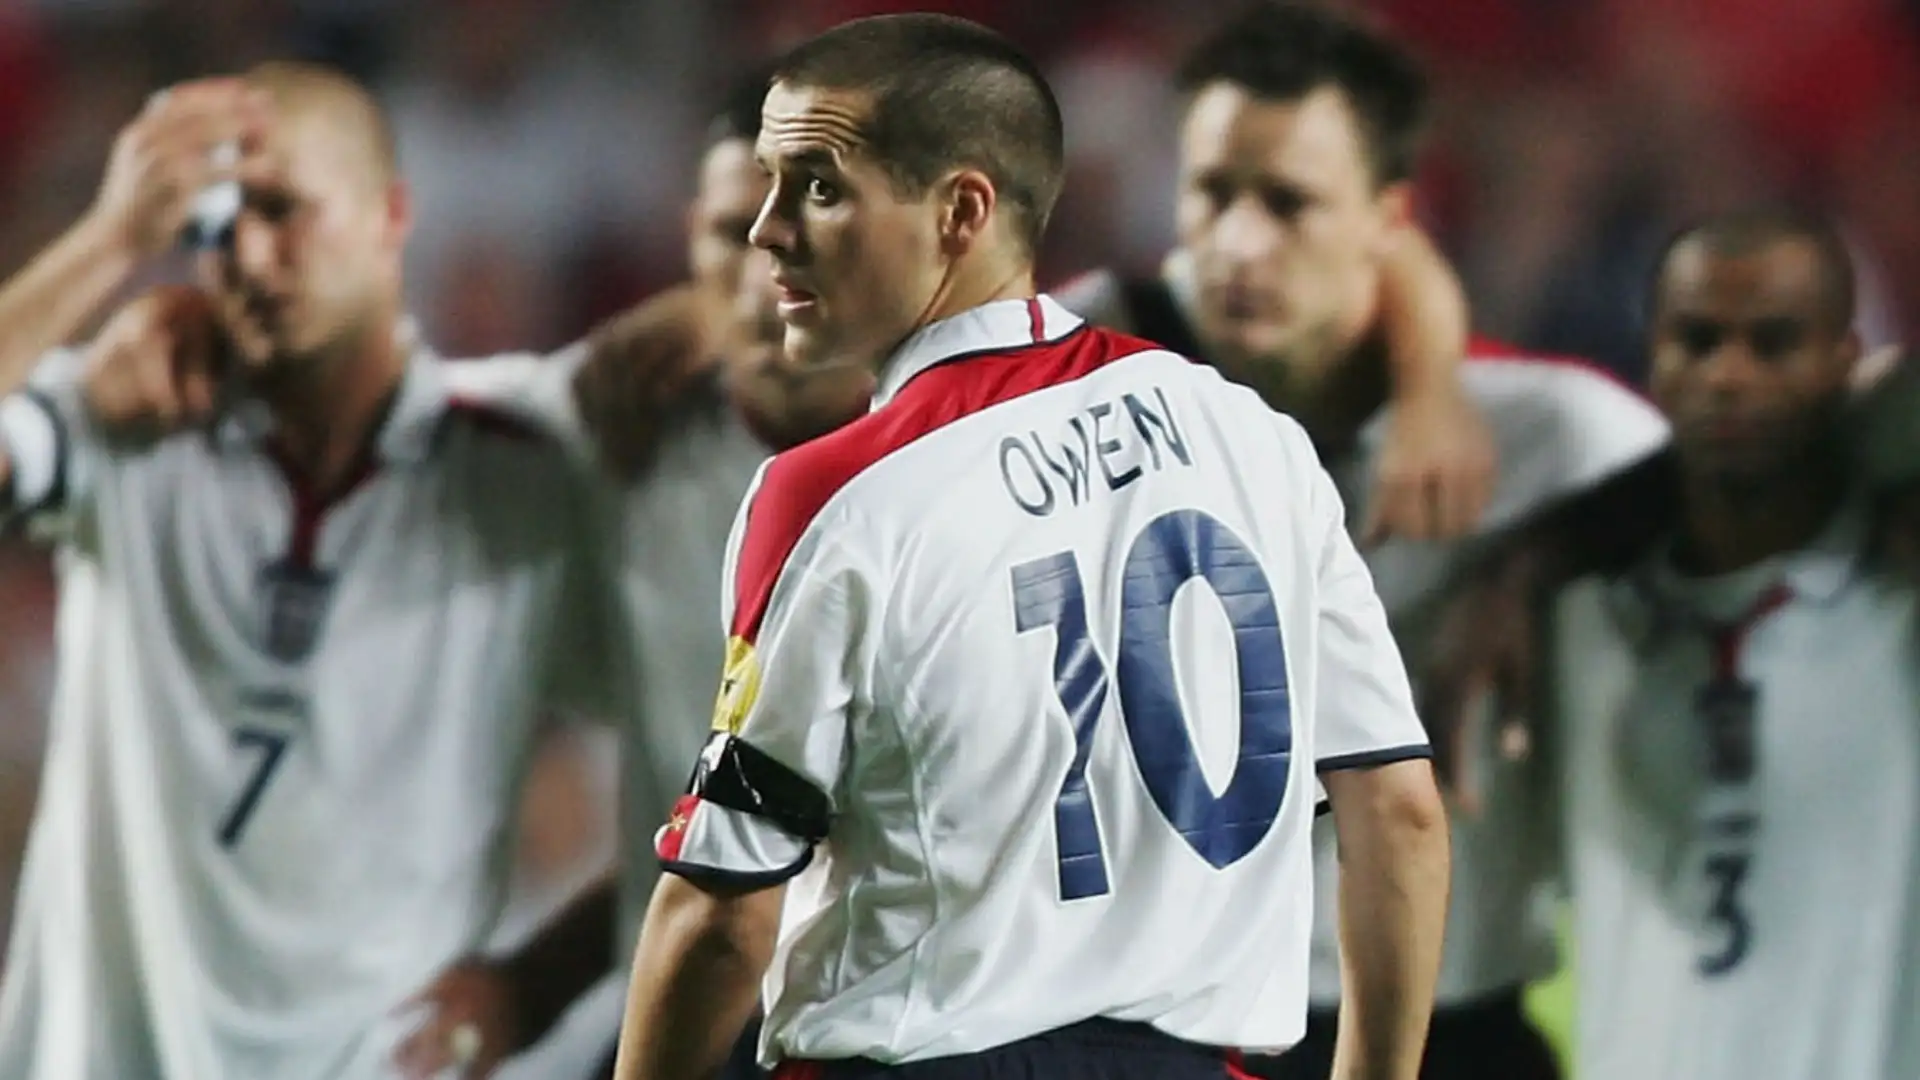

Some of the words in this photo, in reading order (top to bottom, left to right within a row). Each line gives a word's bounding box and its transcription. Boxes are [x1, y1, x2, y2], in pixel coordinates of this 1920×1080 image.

[1000, 387, 1192, 516] OWEN
[1010, 508, 1293, 902] 10
[216, 727, 288, 850] 7
[1697, 854, 1754, 978] 3
